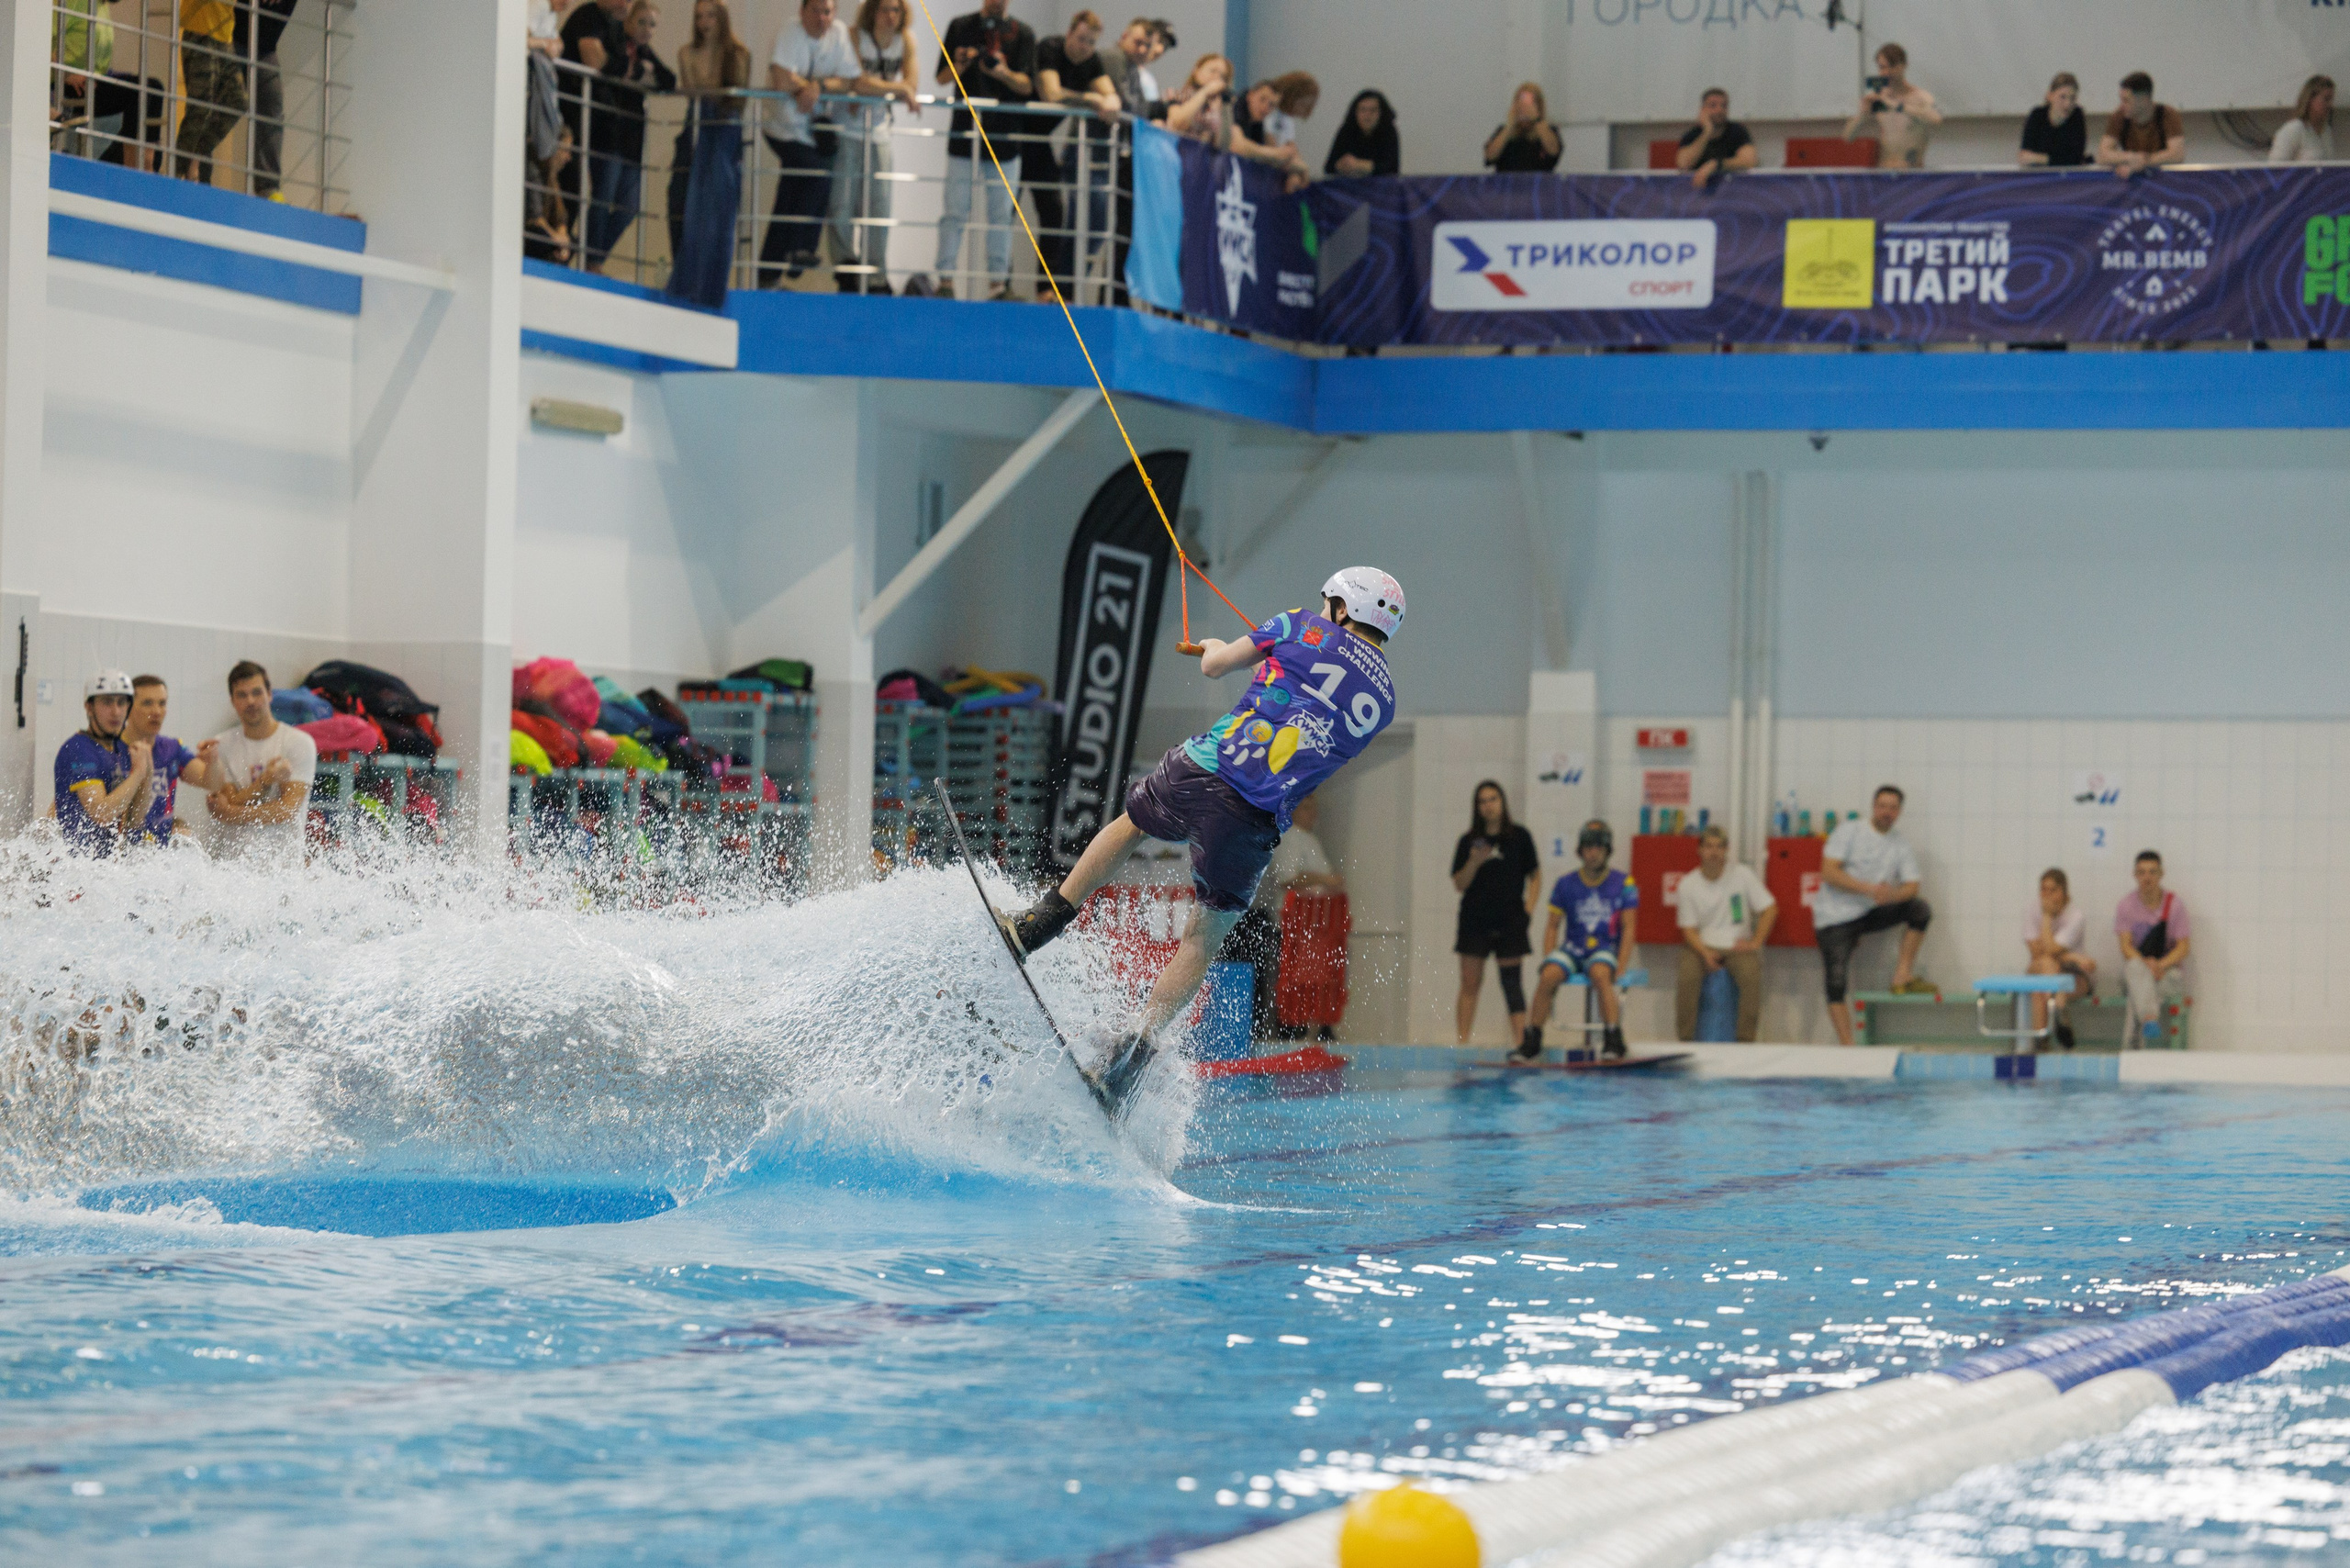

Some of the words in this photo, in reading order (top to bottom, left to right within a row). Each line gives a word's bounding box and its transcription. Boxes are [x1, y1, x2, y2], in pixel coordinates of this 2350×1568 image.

[1506, 242, 1697, 267] ТРИКОЛОР
[1884, 231, 2010, 265] ТРЕТИЙ
[1628, 280, 1695, 297] СПОРТ
[1883, 267, 2009, 304] ПАРК
[1337, 646, 1393, 705] CHALLENGE
[1353, 645, 1390, 688] WINTER
[1061, 643, 1123, 842] STUDIO
[1094, 570, 1134, 631] 21
[1300, 662, 1381, 738] 19
[2092, 826, 2106, 848] 2
